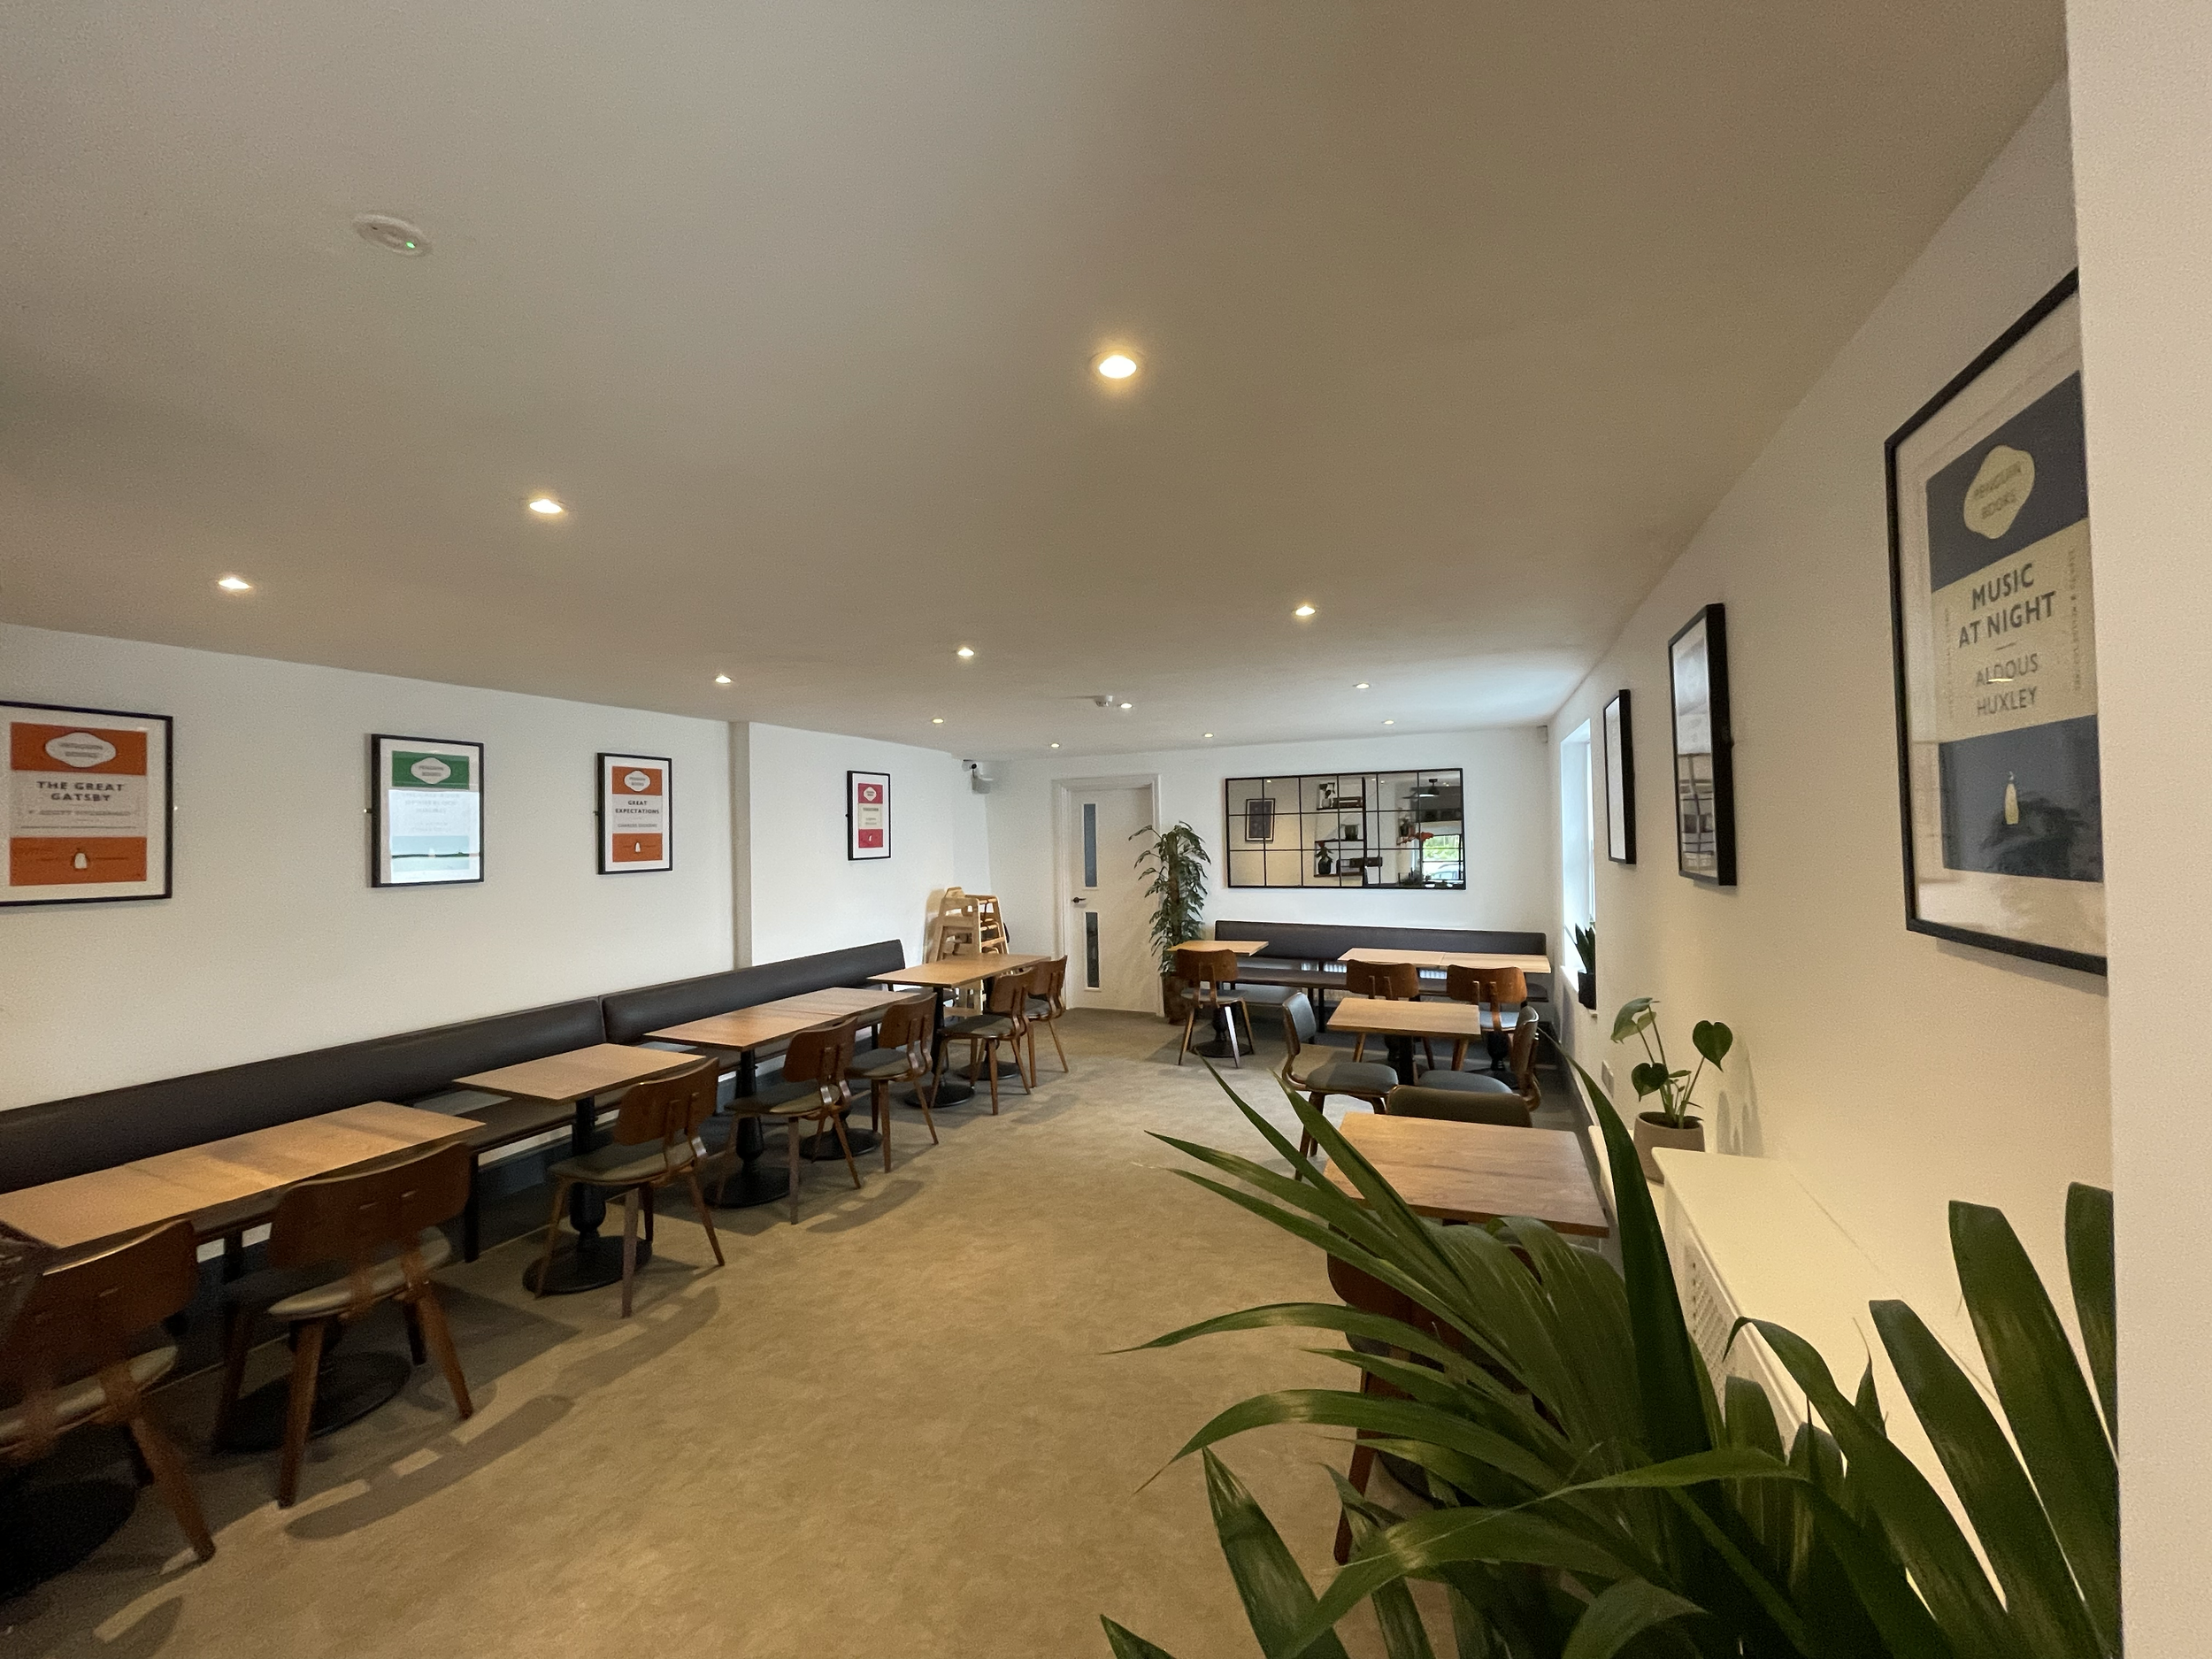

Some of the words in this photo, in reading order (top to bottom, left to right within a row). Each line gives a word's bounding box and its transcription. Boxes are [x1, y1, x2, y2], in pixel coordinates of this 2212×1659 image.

[1971, 562, 2035, 611] MUSIC
[1958, 619, 1982, 649] AT
[1986, 590, 2057, 638] NIGHT
[1975, 652, 2039, 687] ALDOUS
[1976, 686, 2039, 717] HUXLEY
[36, 780, 68, 790] THE
[73, 782, 125, 792] GREAT
[50, 792, 111, 802] GATSBY
